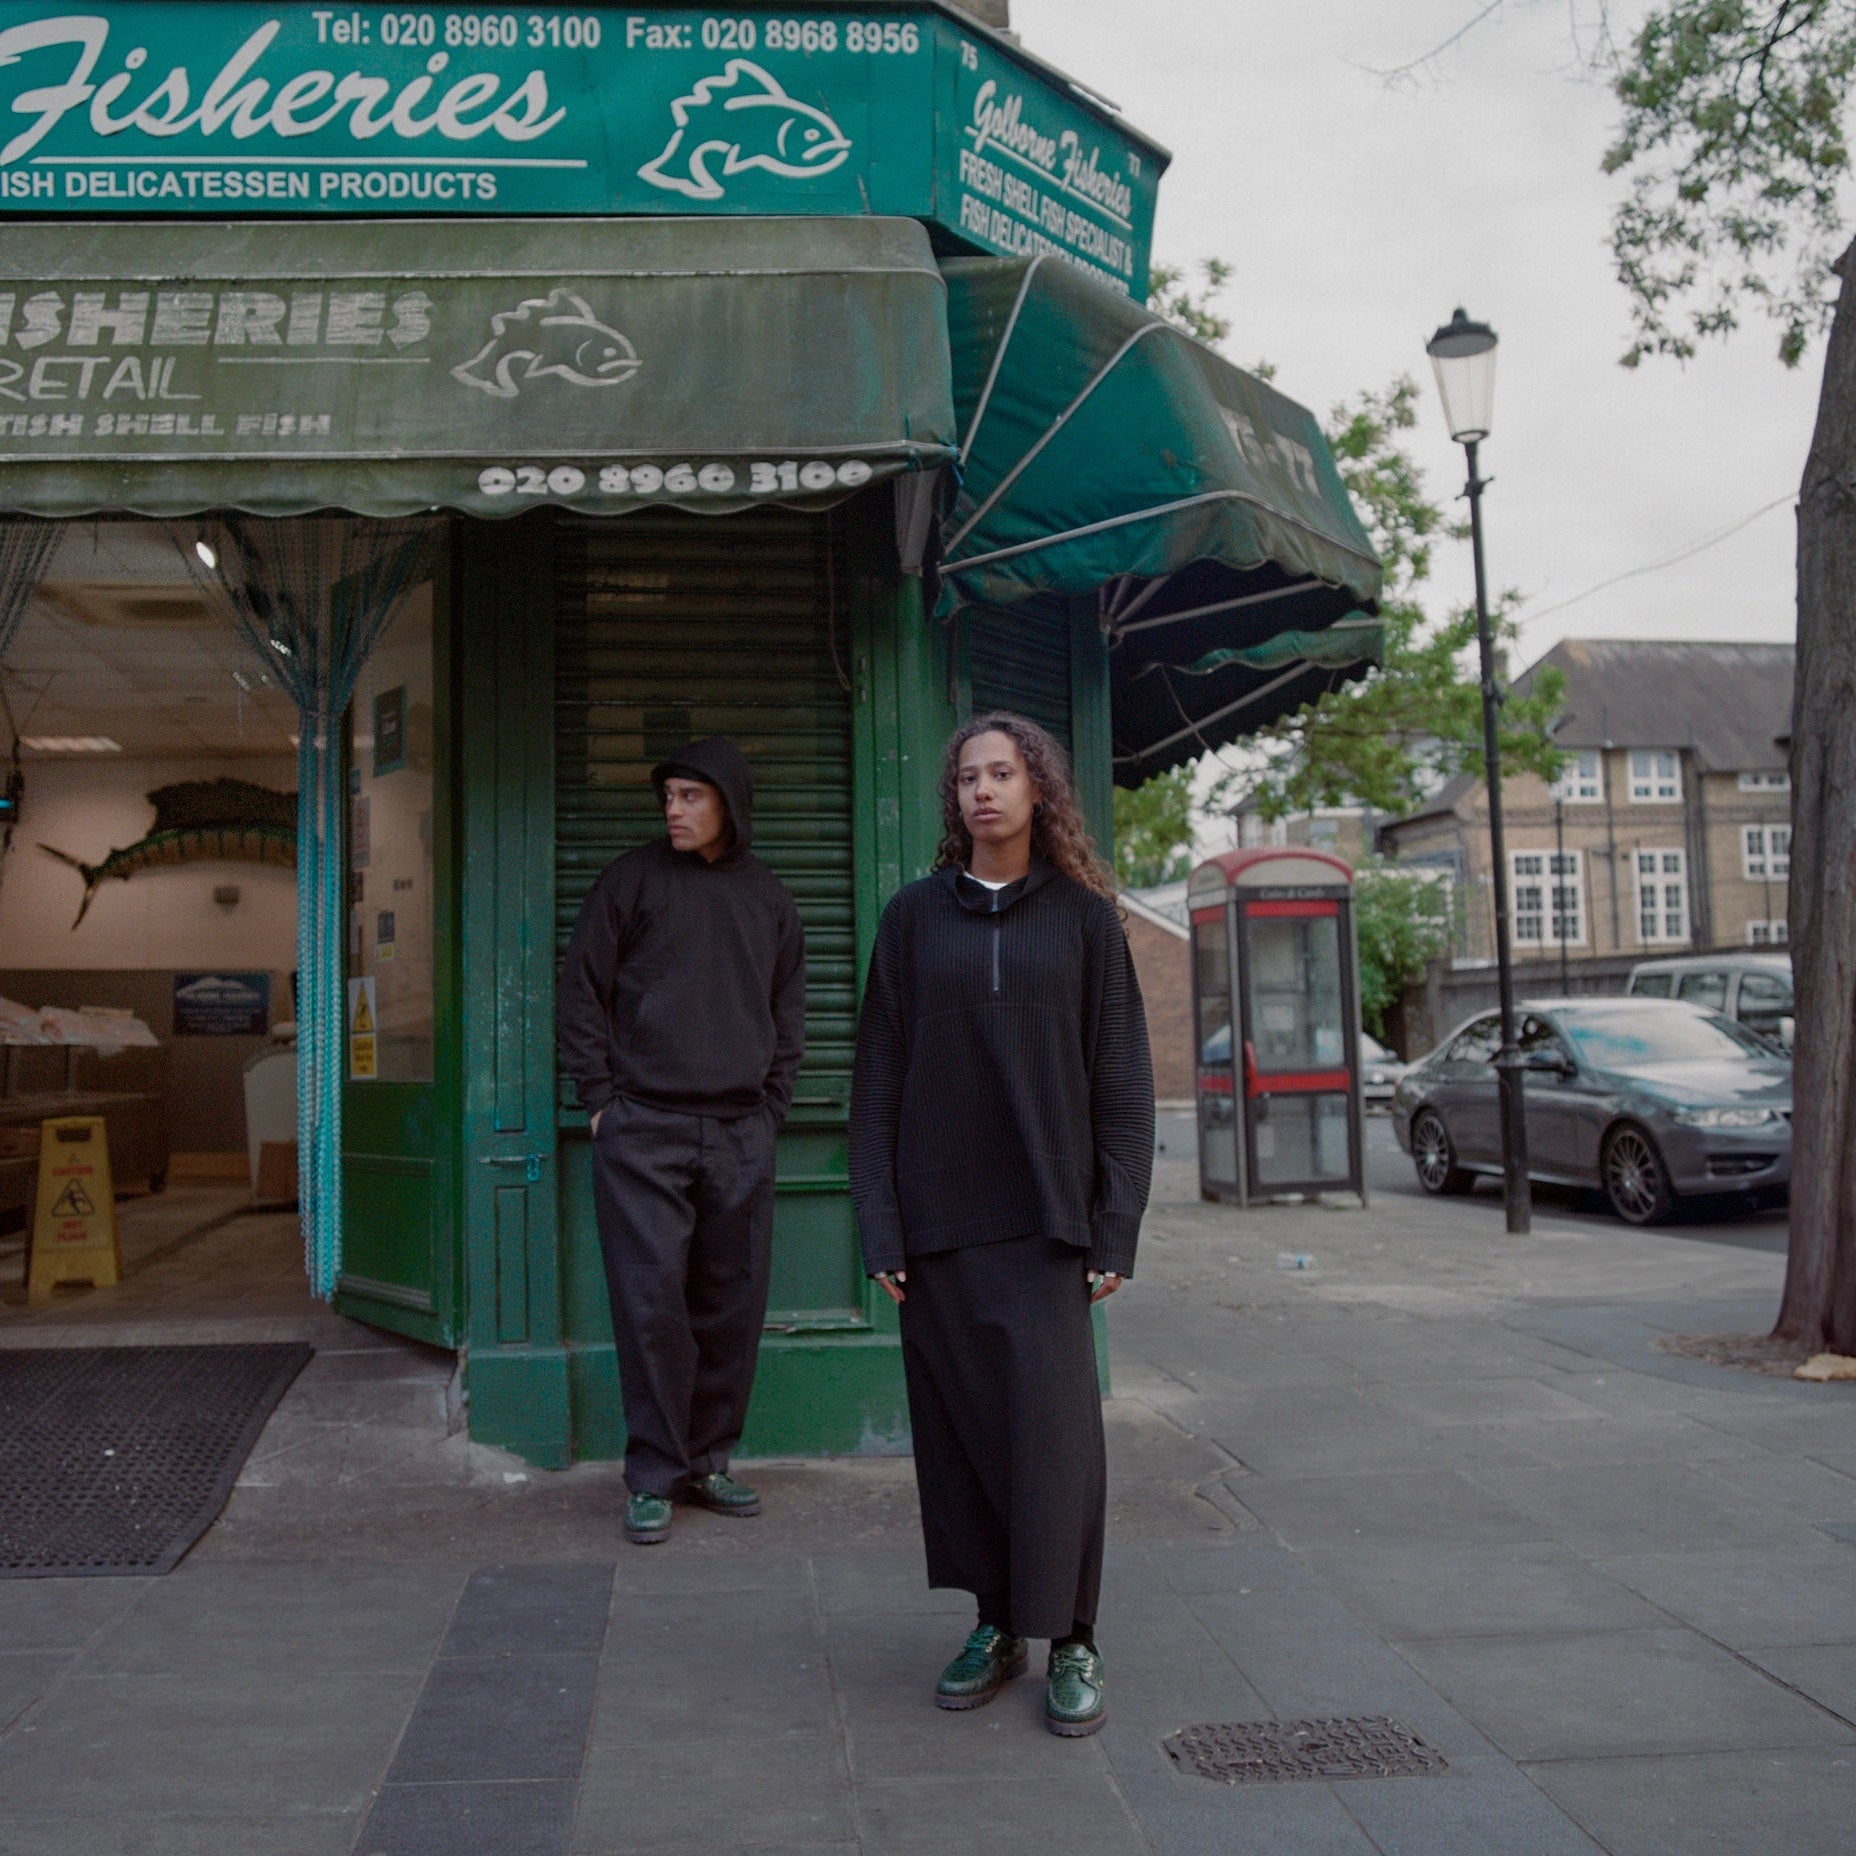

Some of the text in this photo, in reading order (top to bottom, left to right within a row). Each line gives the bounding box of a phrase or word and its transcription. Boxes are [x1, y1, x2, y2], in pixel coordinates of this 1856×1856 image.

[312, 11, 919, 54] Tel: 020 8960 3100 Fax: 020 8968 8956
[959, 39, 978, 71] 75
[0, 15, 567, 166] Fisheries
[974, 79, 1133, 219] Golborne Fisheries
[2, 171, 497, 200] ISH DELICATESSEN PRODUCTS
[960, 148, 1004, 201] FRESH
[1003, 173, 1040, 224] SHELL
[1040, 195, 1067, 239] FISH
[1065, 210, 1124, 272] SPECIALIST
[1124, 246, 1133, 277] &
[960, 193, 991, 239] FISH
[94, 413, 225, 437] SHELL
[236, 413, 331, 437] FISH
[478, 460, 873, 495] 020 8960 3100
